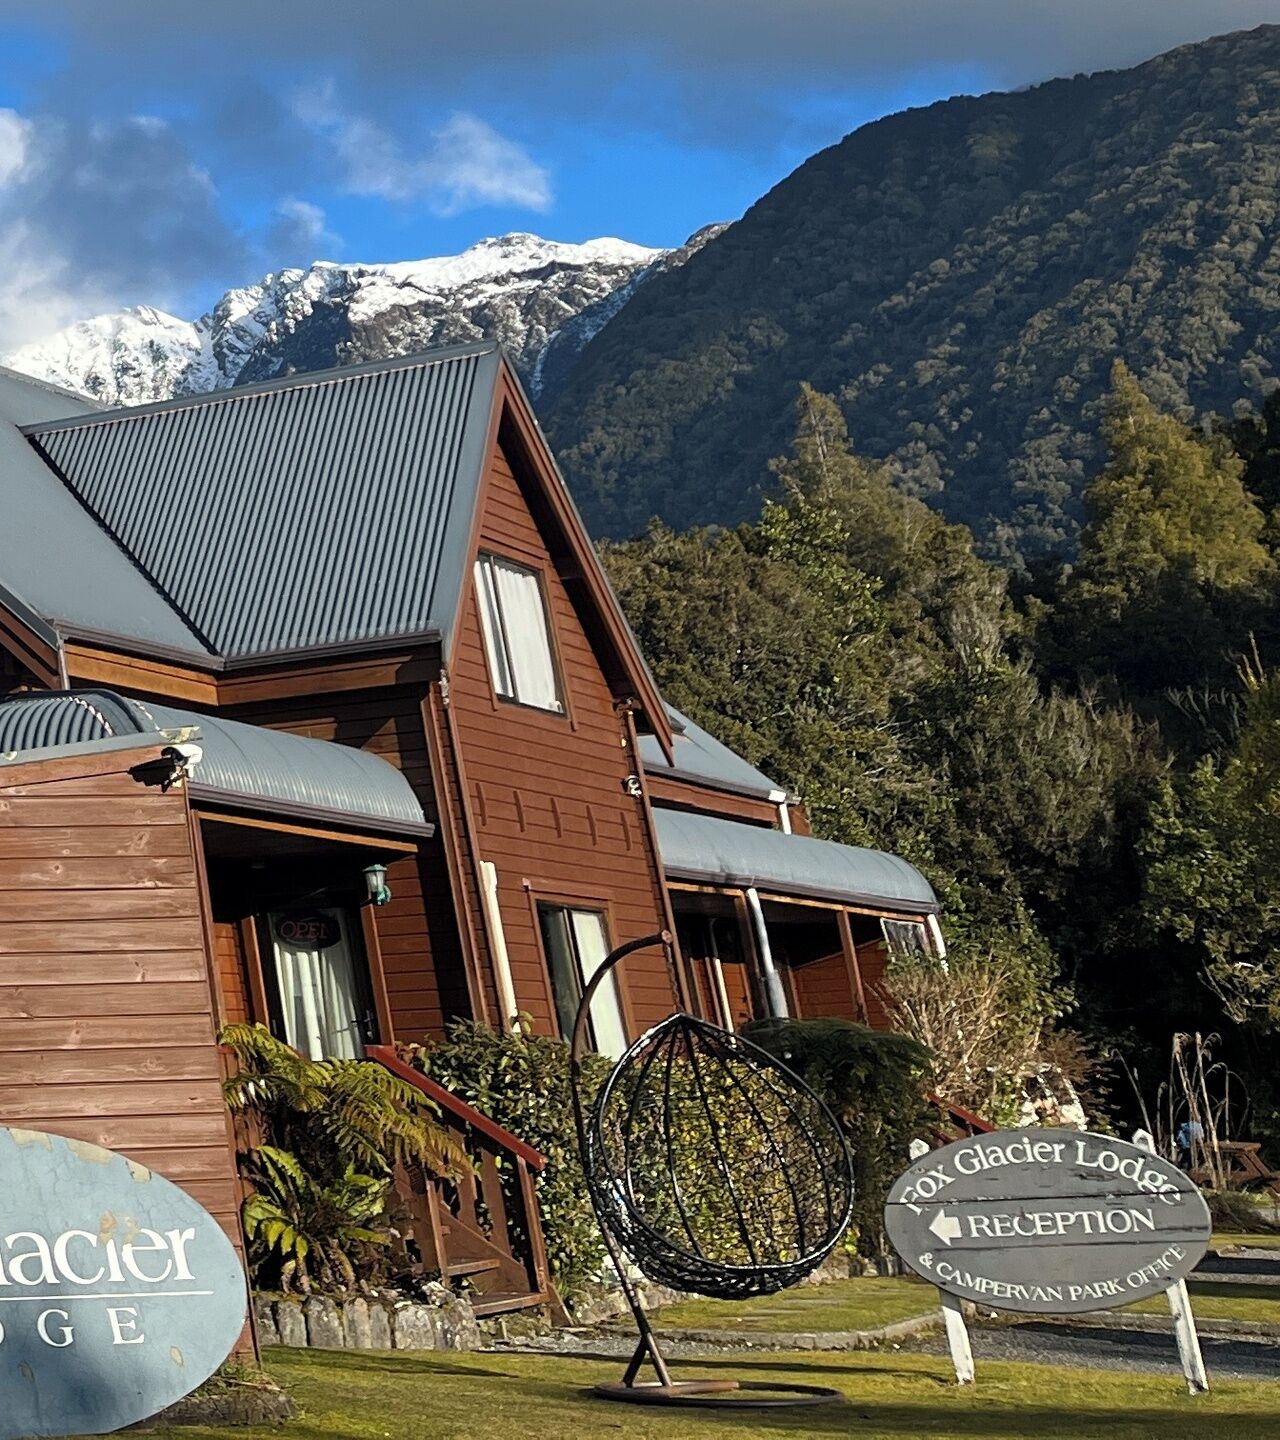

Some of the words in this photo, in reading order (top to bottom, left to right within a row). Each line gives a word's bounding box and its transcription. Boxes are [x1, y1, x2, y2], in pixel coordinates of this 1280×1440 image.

[900, 1165, 956, 1215] Fox
[953, 1136, 1066, 1175] Glacier
[1075, 1140, 1182, 1206] Lodge
[967, 1208, 1156, 1238] RECEPTION
[935, 1262, 1063, 1302] CAMPERVAN
[1068, 1278, 1126, 1301] PARK
[1126, 1243, 1187, 1289] OFFICE
